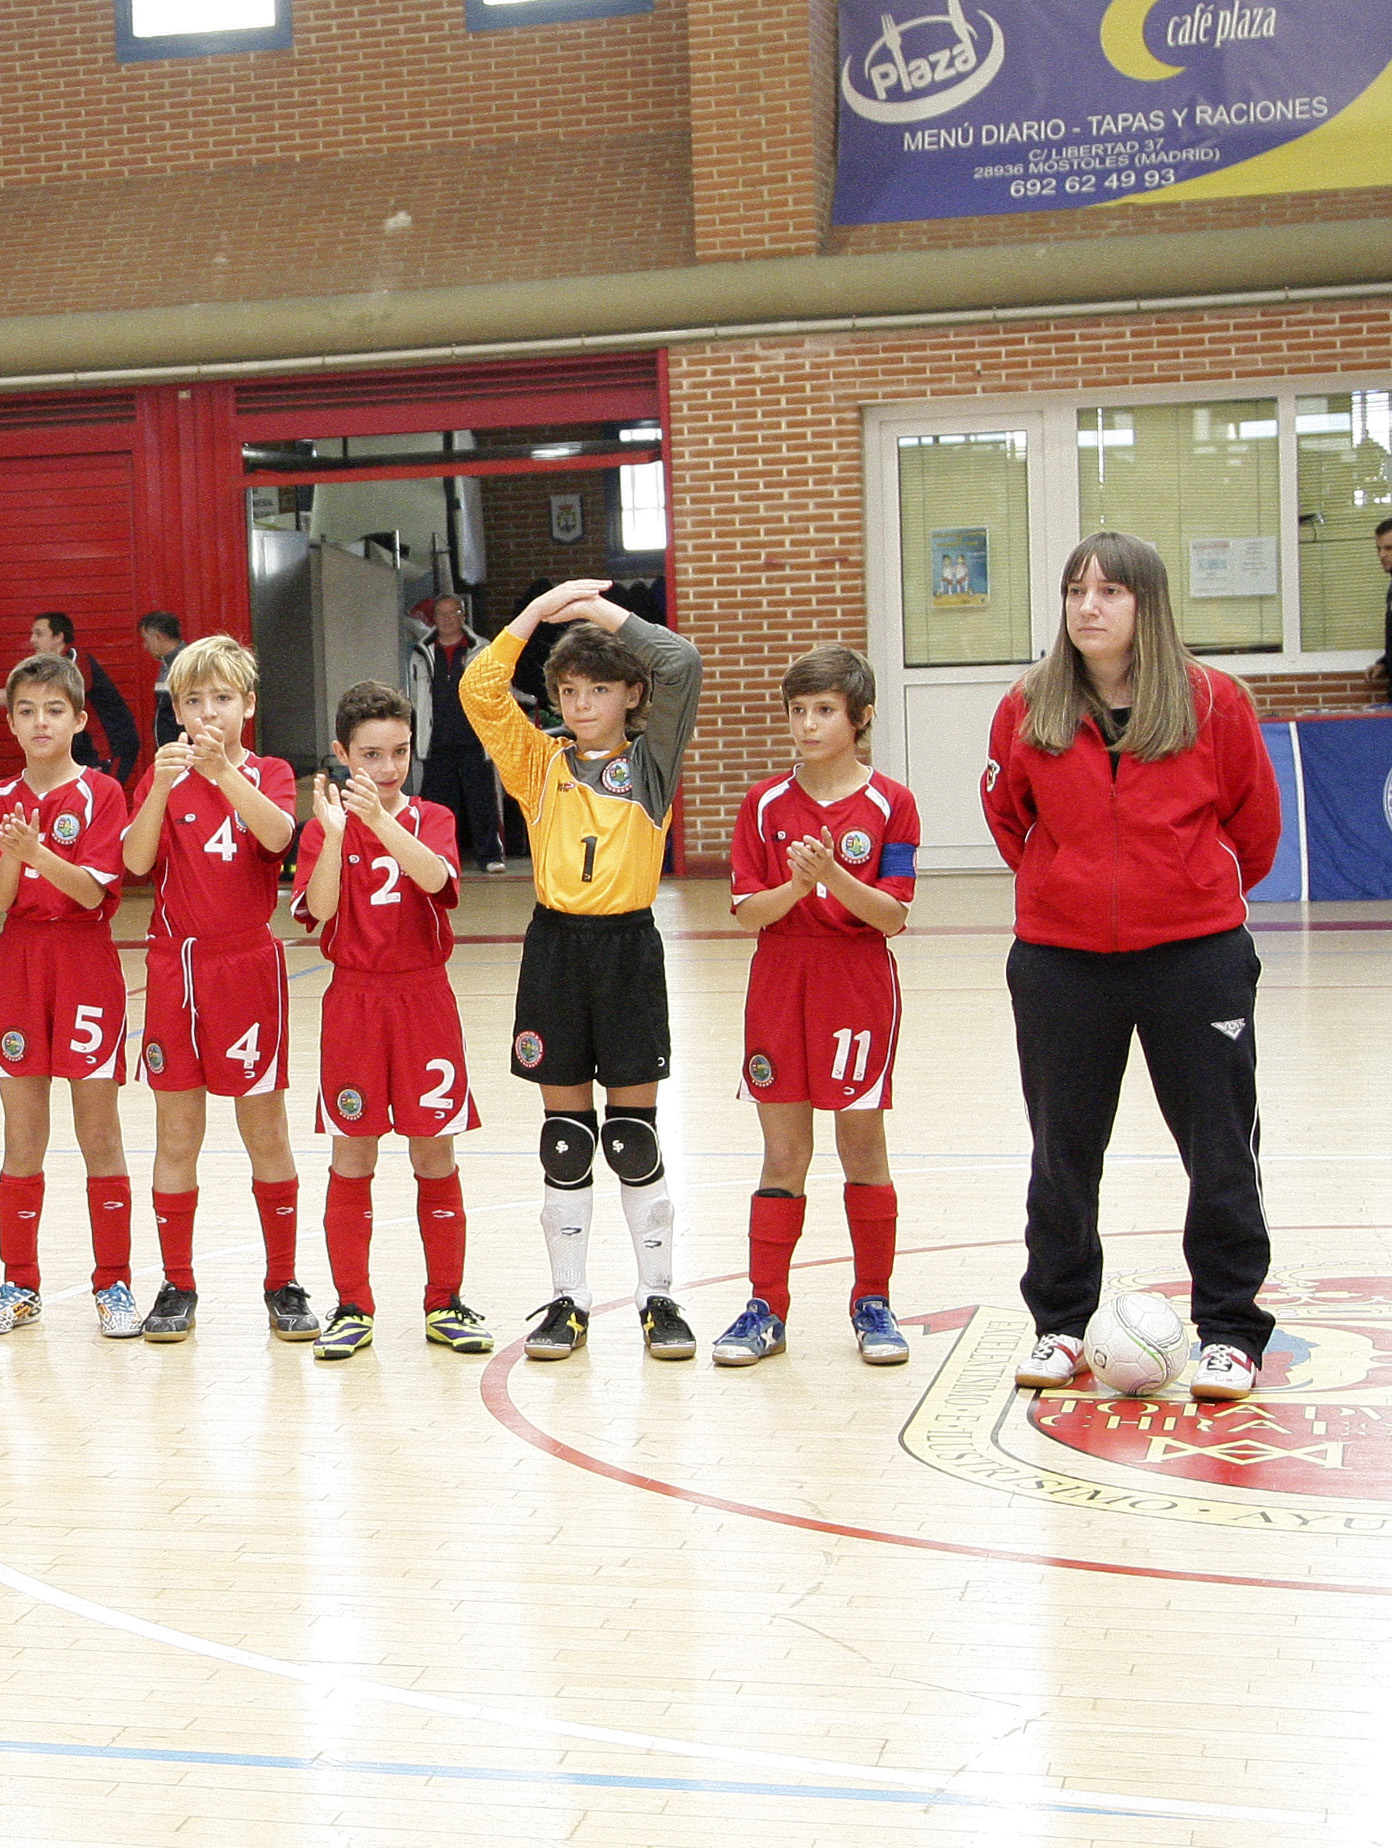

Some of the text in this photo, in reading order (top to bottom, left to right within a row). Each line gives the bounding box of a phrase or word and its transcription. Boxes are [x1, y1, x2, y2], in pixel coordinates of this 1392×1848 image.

[1167, 0, 1276, 48] café plaza
[870, 30, 977, 100] Plaza
[903, 122, 974, 151] MENÚ
[981, 118, 1066, 145] DIARIO
[1088, 109, 1165, 135] TAPAS
[1171, 107, 1189, 127] Y
[1195, 96, 1329, 126] RACIONES
[973, 163, 1024, 179] 28936
[1134, 147, 1220, 167] (MADRID)
[1028, 137, 1165, 162] C/ LIBERTAD 37
[1010, 168, 1176, 197] 692 62 49 93
[204, 815, 238, 862] 4
[580, 835, 597, 883] 1
[370, 856, 402, 906] 2
[70, 1004, 105, 1054] 5
[226, 1022, 261, 1069] 4
[830, 1028, 872, 1082] 11
[419, 1058, 456, 1110] 2
